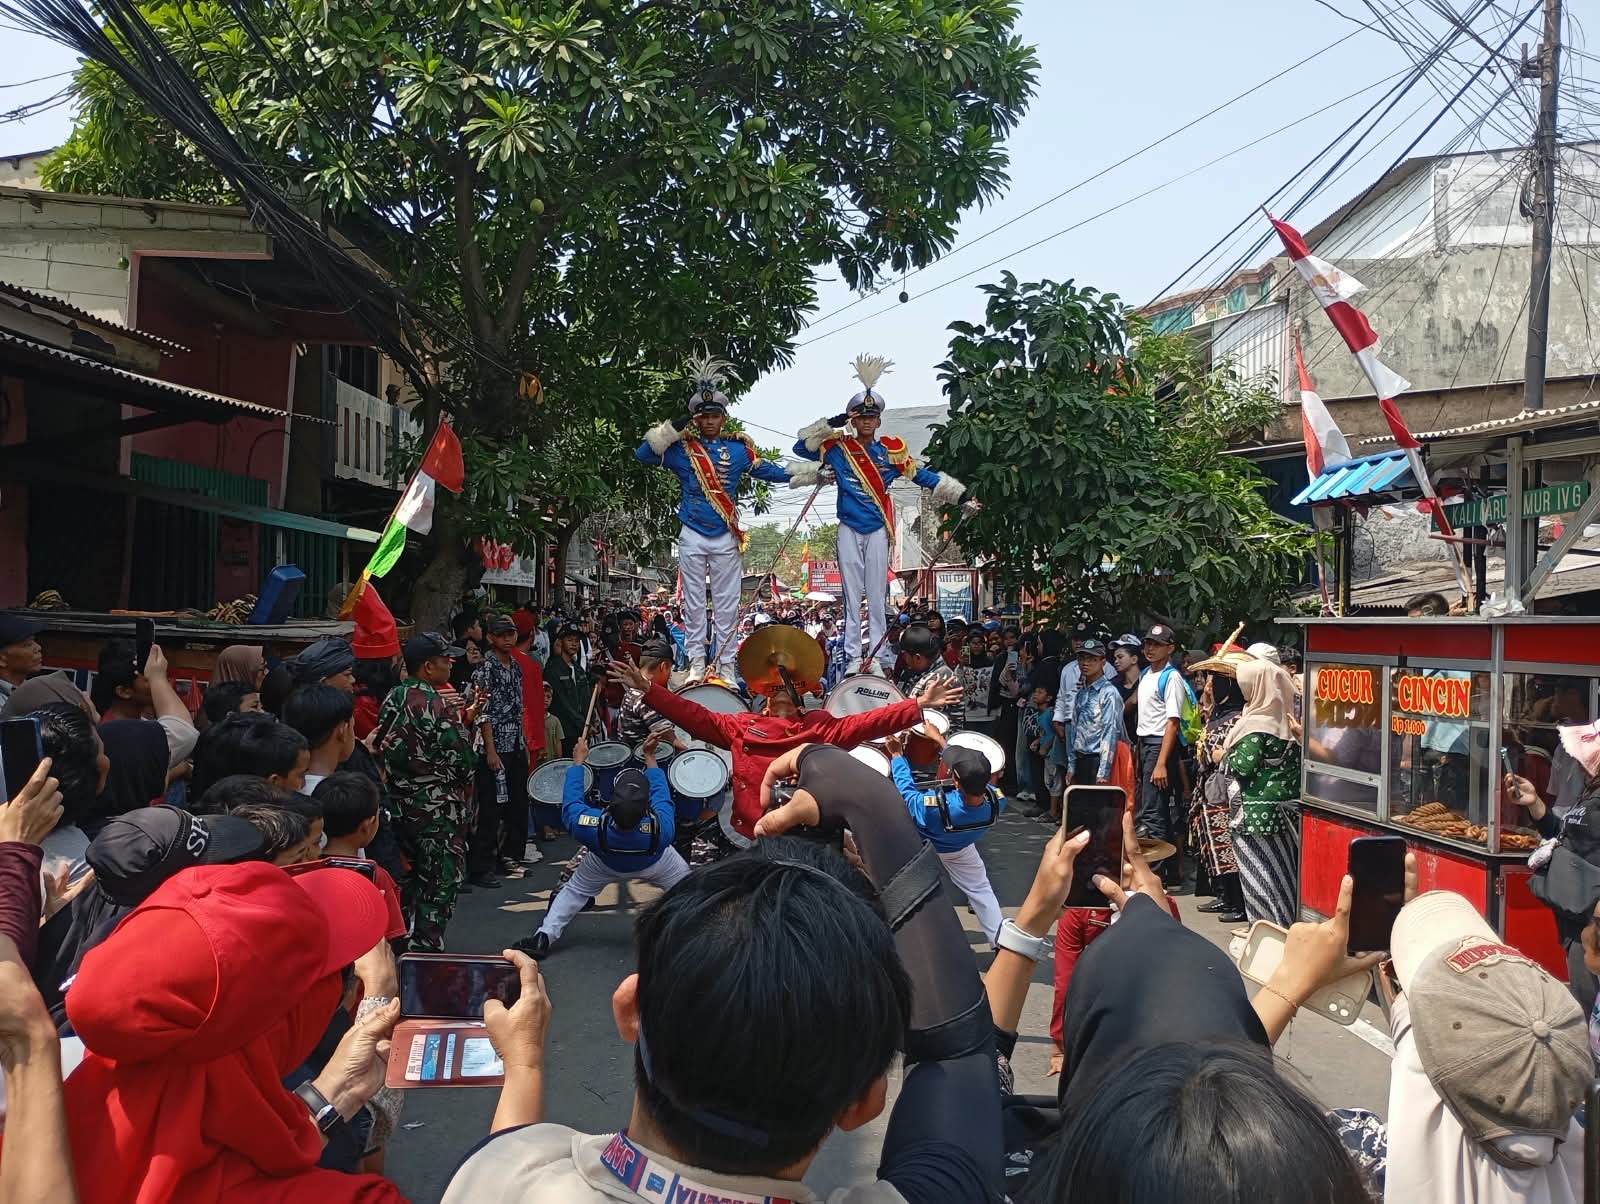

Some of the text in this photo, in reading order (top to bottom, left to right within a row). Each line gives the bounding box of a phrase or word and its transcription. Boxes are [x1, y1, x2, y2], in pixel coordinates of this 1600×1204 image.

[1452, 505, 1476, 526] KALI
[1523, 490, 1550, 516] MUR
[1317, 668, 1374, 705] CUCUR
[1398, 675, 1472, 718] CINCIN
[1391, 715, 1405, 735] Rp
